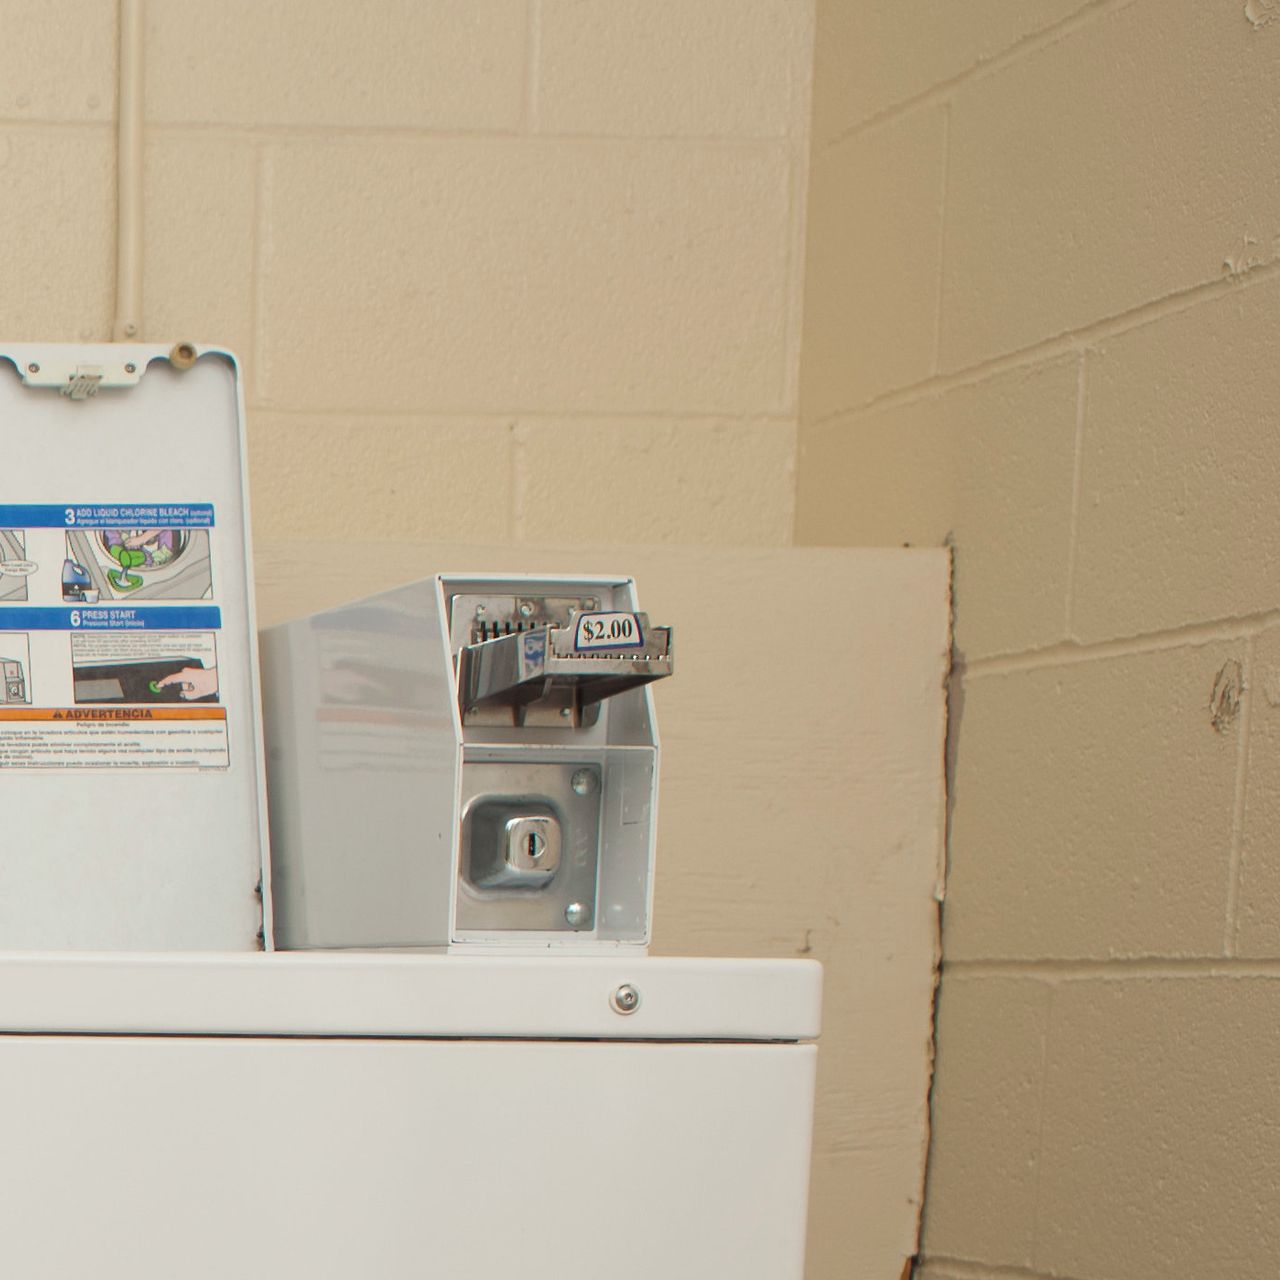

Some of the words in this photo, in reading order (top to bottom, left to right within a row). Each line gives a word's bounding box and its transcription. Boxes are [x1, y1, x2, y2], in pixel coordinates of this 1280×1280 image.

[65, 508, 75, 524] 3
[76, 508, 92, 517] ADD
[94, 508, 118, 517] LIQUID
[120, 508, 157, 517] CHLORINE
[159, 508, 189, 517] BLEACH
[71, 610, 80, 627] 6
[82, 610, 108, 619] PRESS
[110, 610, 136, 619] START
[583, 618, 633, 641] $2.00
[66, 709, 153, 718] ADVERTENCIA
